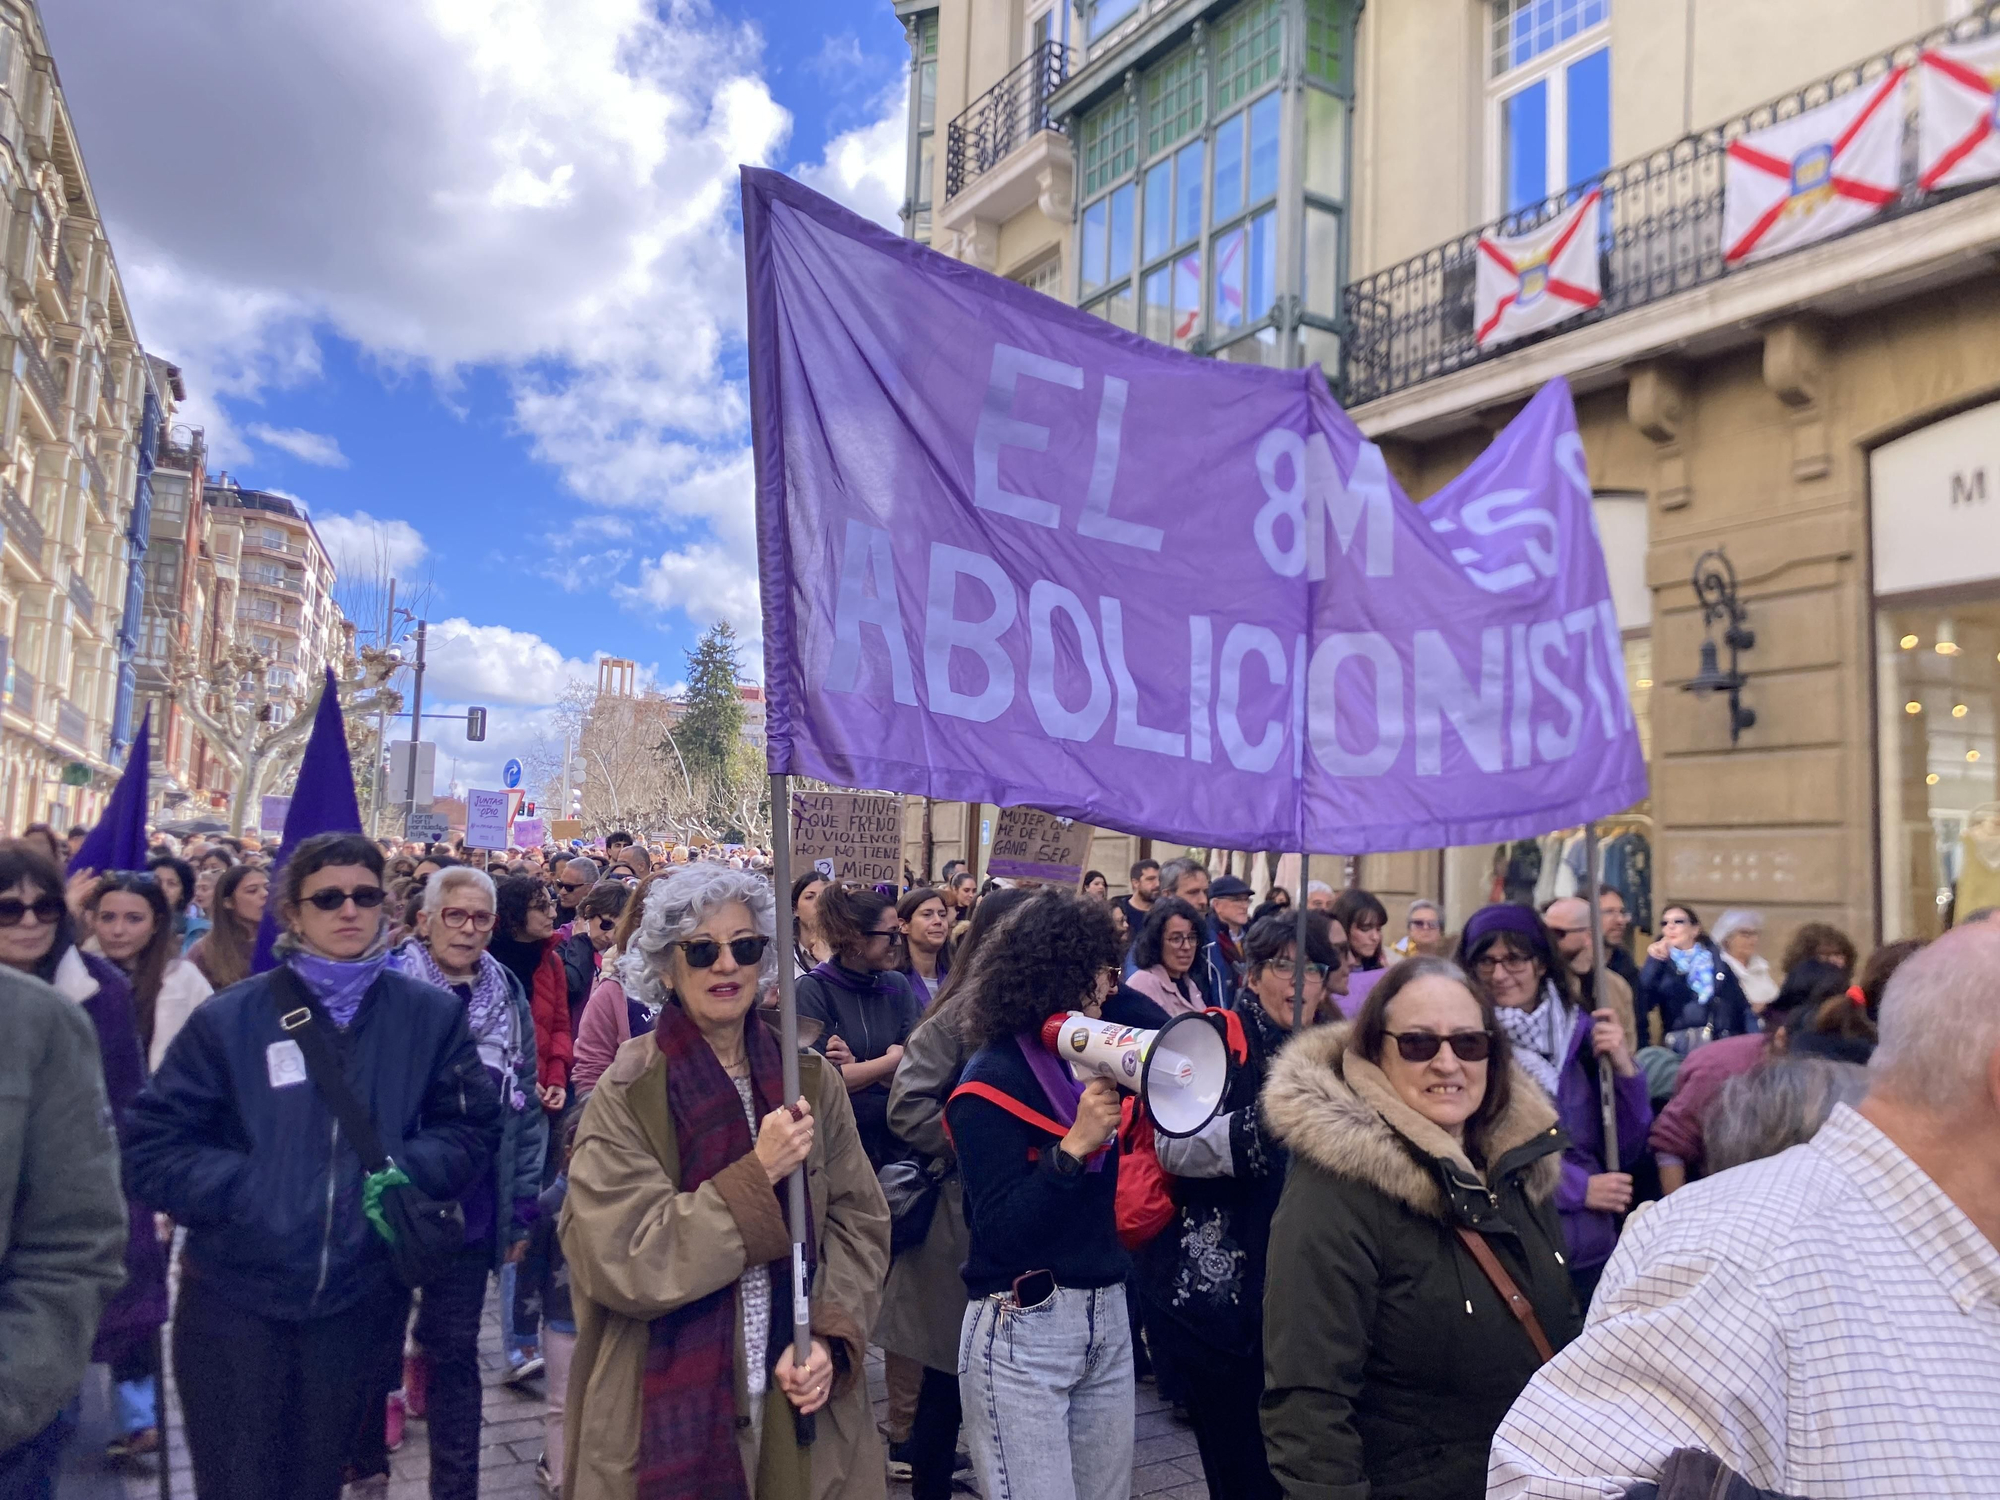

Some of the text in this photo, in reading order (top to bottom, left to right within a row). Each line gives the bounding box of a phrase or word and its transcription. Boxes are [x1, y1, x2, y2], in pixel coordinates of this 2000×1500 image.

[973, 342, 1165, 552] EL
[1253, 428, 1393, 582] 8M
[814, 796, 833, 812] LA
[809, 812, 840, 828] QUE
[1001, 810, 1046, 827] MUJER
[793, 827, 815, 841] TU
[997, 823, 1061, 843] ME DE LA
[795, 843, 900, 859] HOY NO TIENE
[993, 840, 1071, 863] GANA SER
